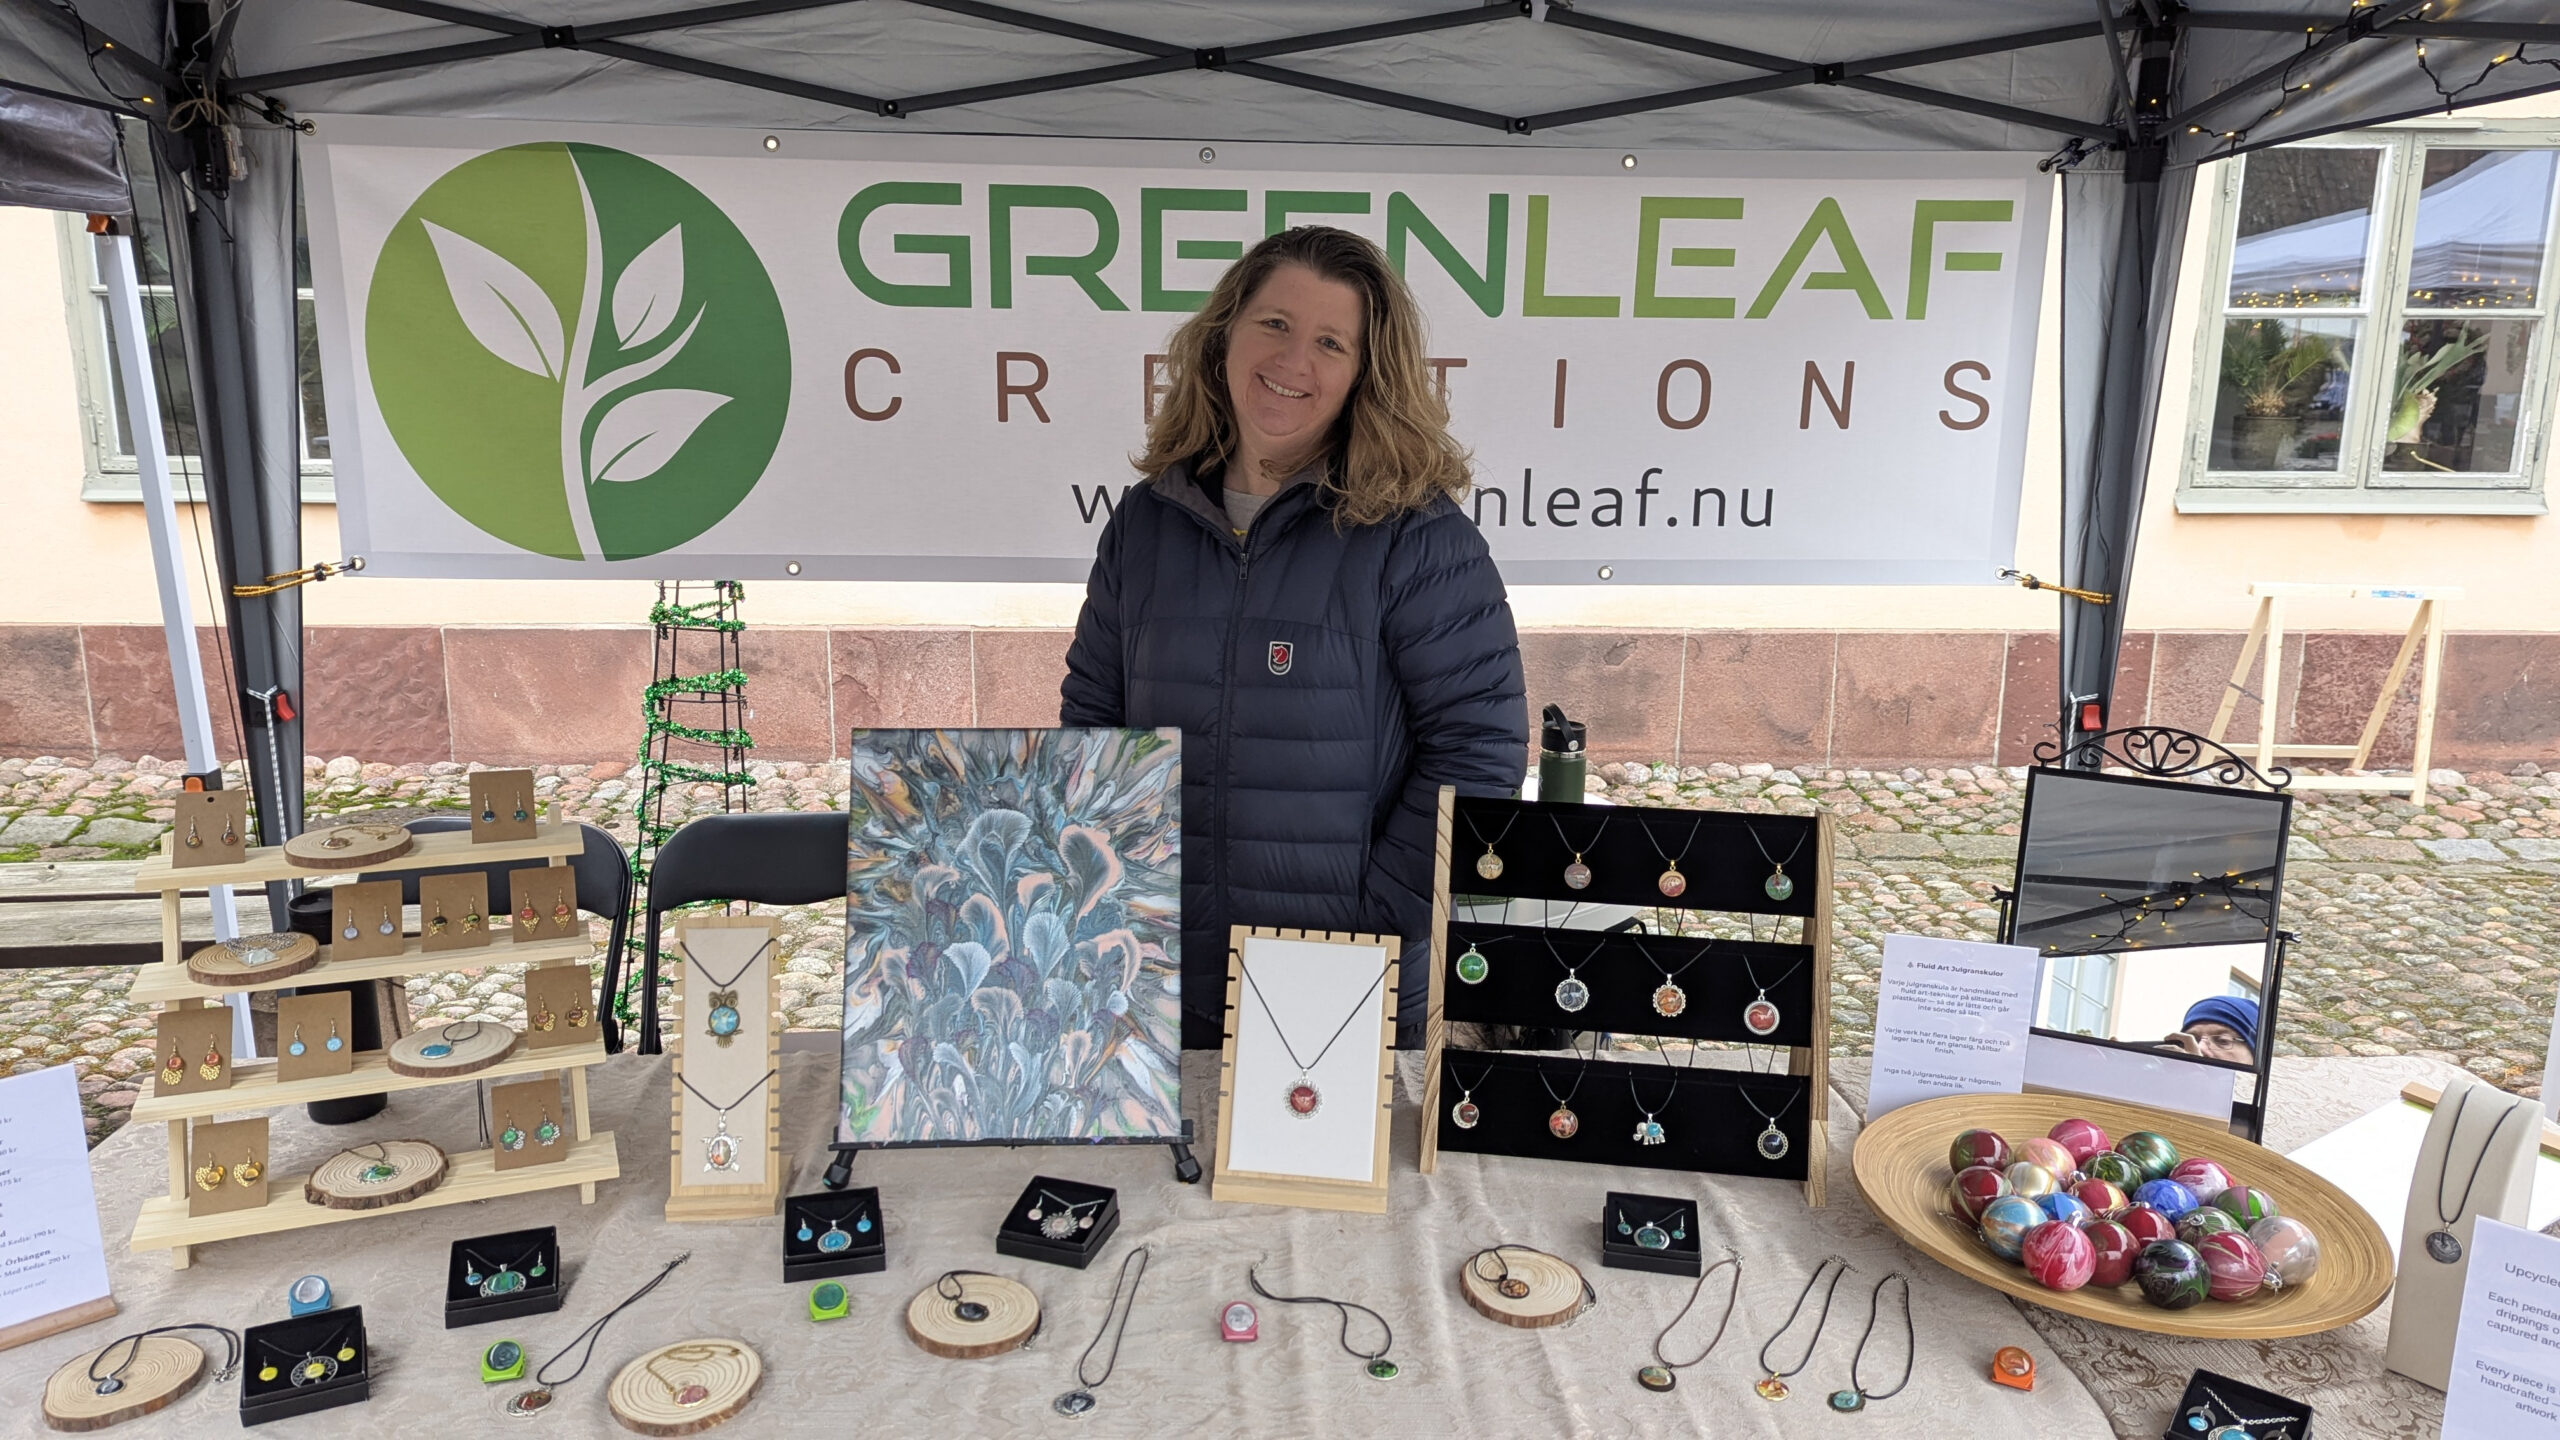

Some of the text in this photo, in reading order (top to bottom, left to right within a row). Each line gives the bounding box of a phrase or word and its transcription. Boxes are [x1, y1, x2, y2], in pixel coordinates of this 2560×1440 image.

[845, 348, 1993, 431] CRETIONS
[1917, 962, 1936, 970] Fluid
[1951, 966, 2004, 977] Julgranskulor
[2488, 1291, 2519, 1308] Each
[2487, 1318, 2539, 1342] captured
[2496, 1308, 2550, 1332] drippings
[2476, 1359, 2556, 1393] Every piece is
[2480, 1374, 2550, 1405] handcrafted
[2515, 1401, 2558, 1421] artwork
